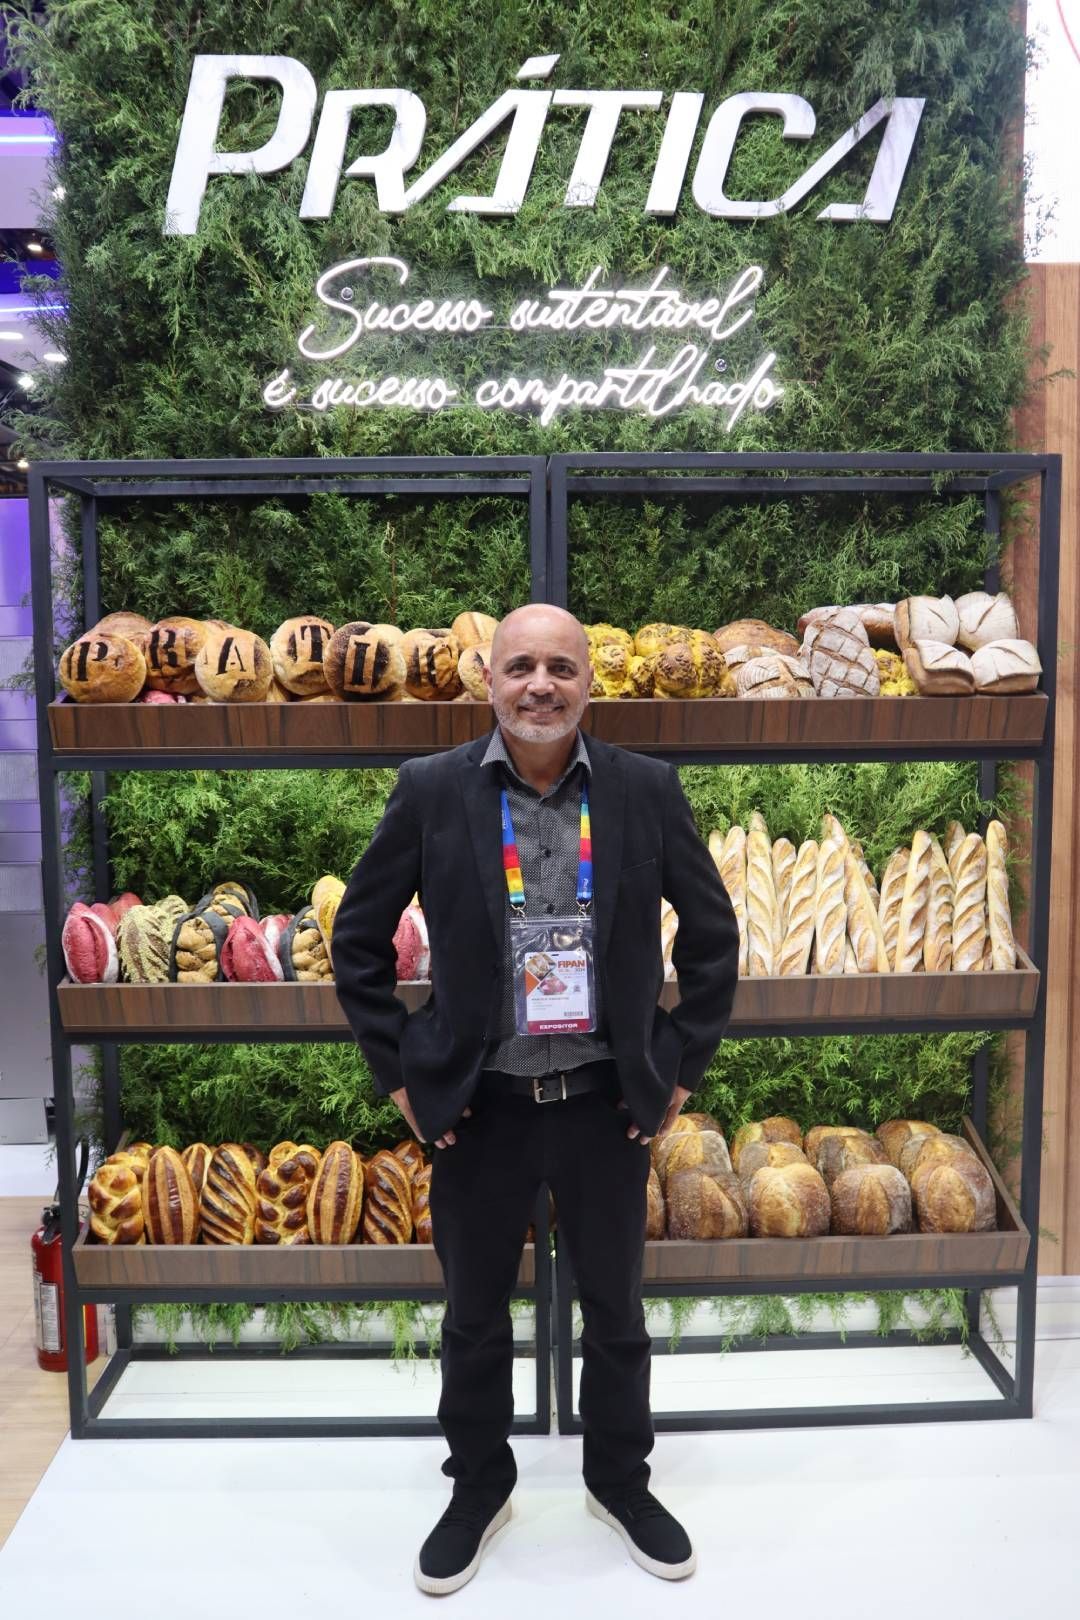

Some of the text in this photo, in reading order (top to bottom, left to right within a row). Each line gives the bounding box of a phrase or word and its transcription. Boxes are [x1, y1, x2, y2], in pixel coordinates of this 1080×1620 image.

[162, 53, 926, 237] PRÁTICA
[297, 255, 494, 360] Sucesso
[311, 376, 458, 411] sucesso
[475, 343, 785, 433] compartilhado
